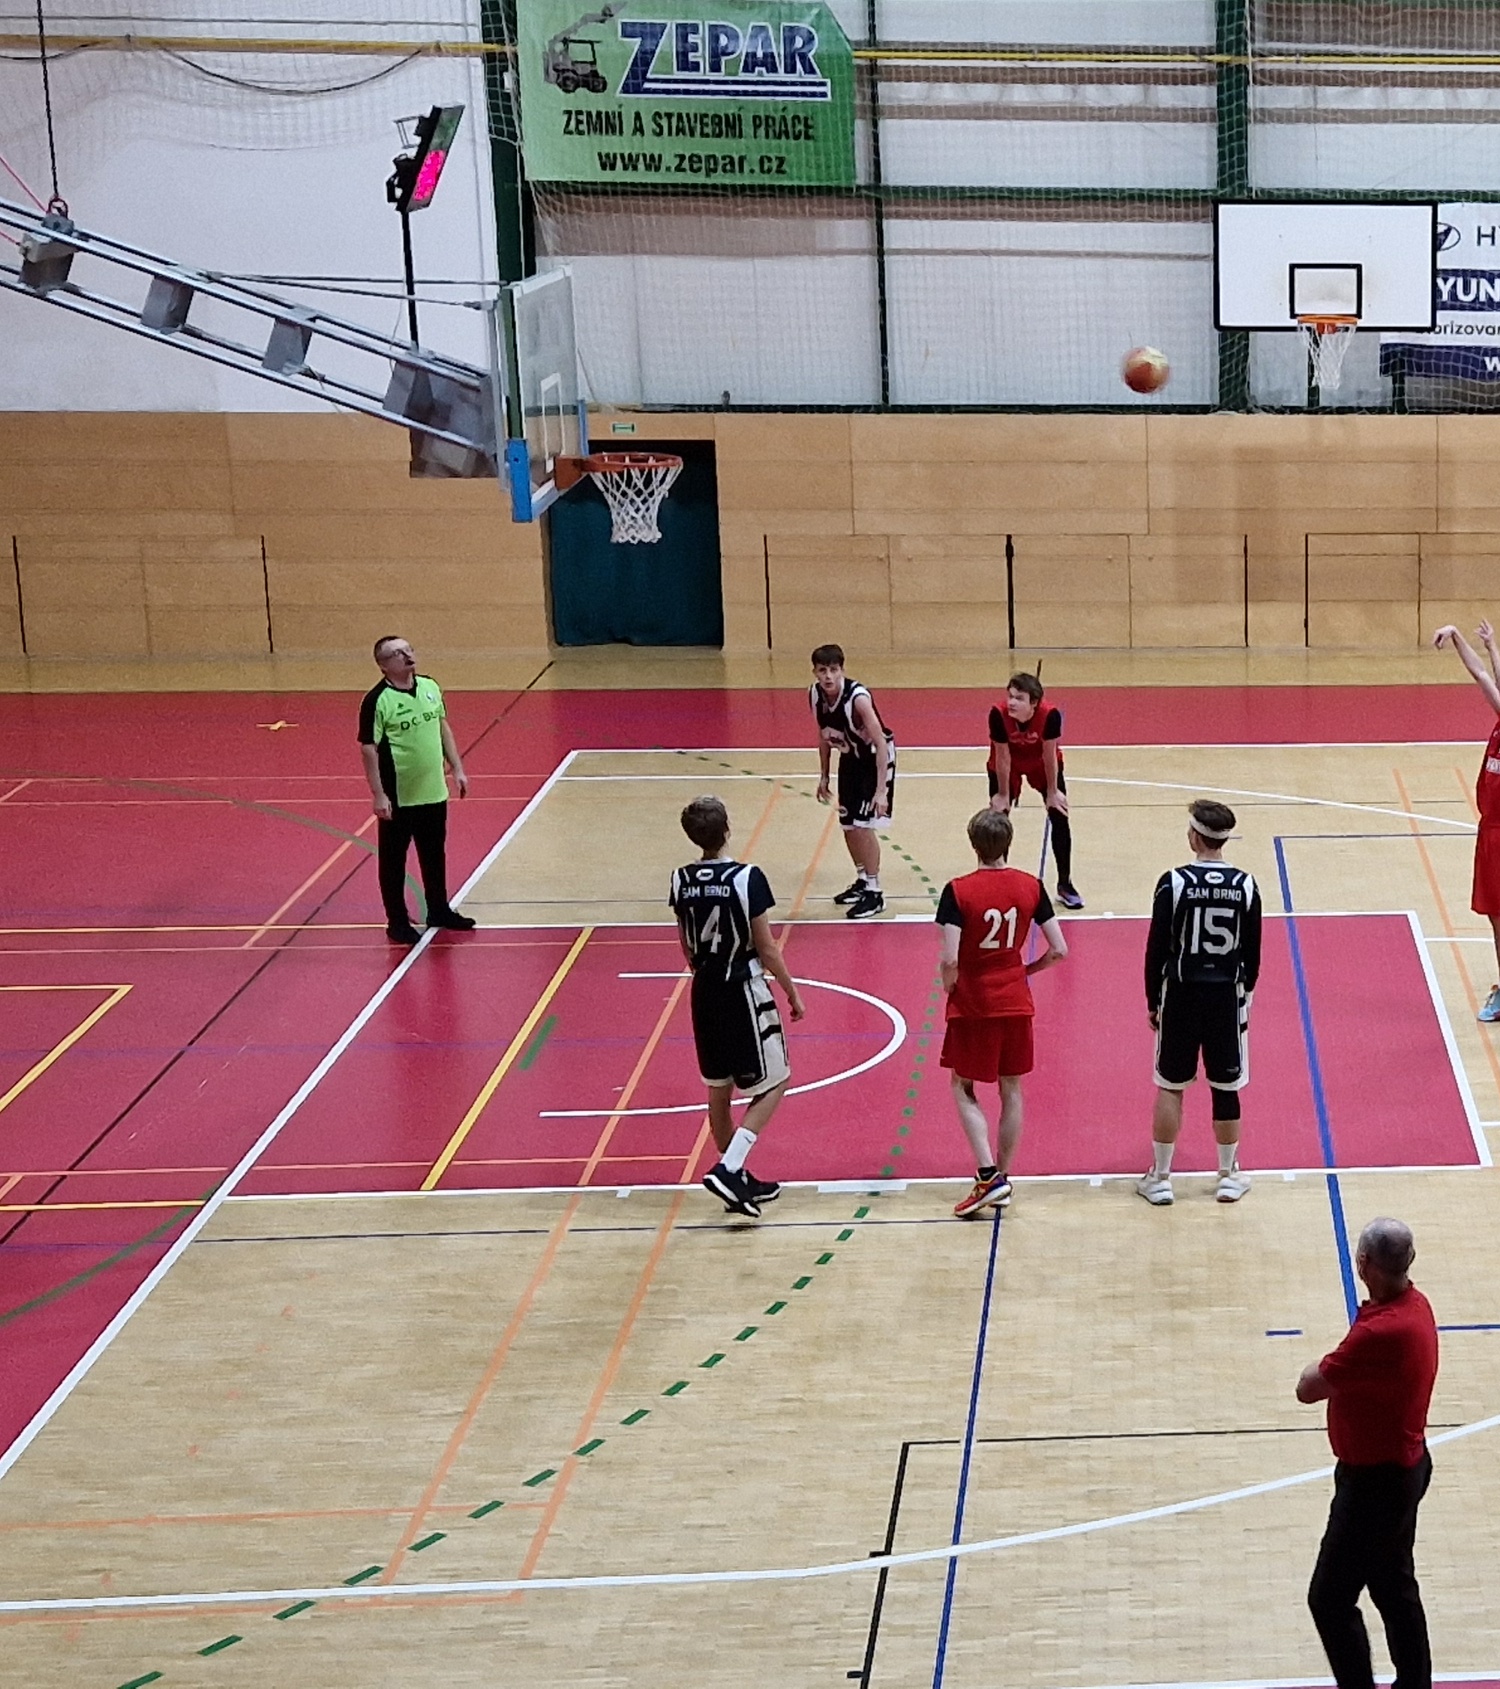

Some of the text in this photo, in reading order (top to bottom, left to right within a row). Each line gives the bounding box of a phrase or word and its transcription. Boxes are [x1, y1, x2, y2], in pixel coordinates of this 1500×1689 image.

[616, 18, 828, 99] ZEPAR
[563, 105, 815, 141] ZEMNÍ A STAVEBNÍ PRÁCE
[597, 151, 787, 178] www.zepar.cz
[1187, 888, 1242, 901] SAM BRNO
[701, 905, 722, 953] 4
[979, 908, 1017, 949] 21
[1191, 907, 1235, 955] 15
